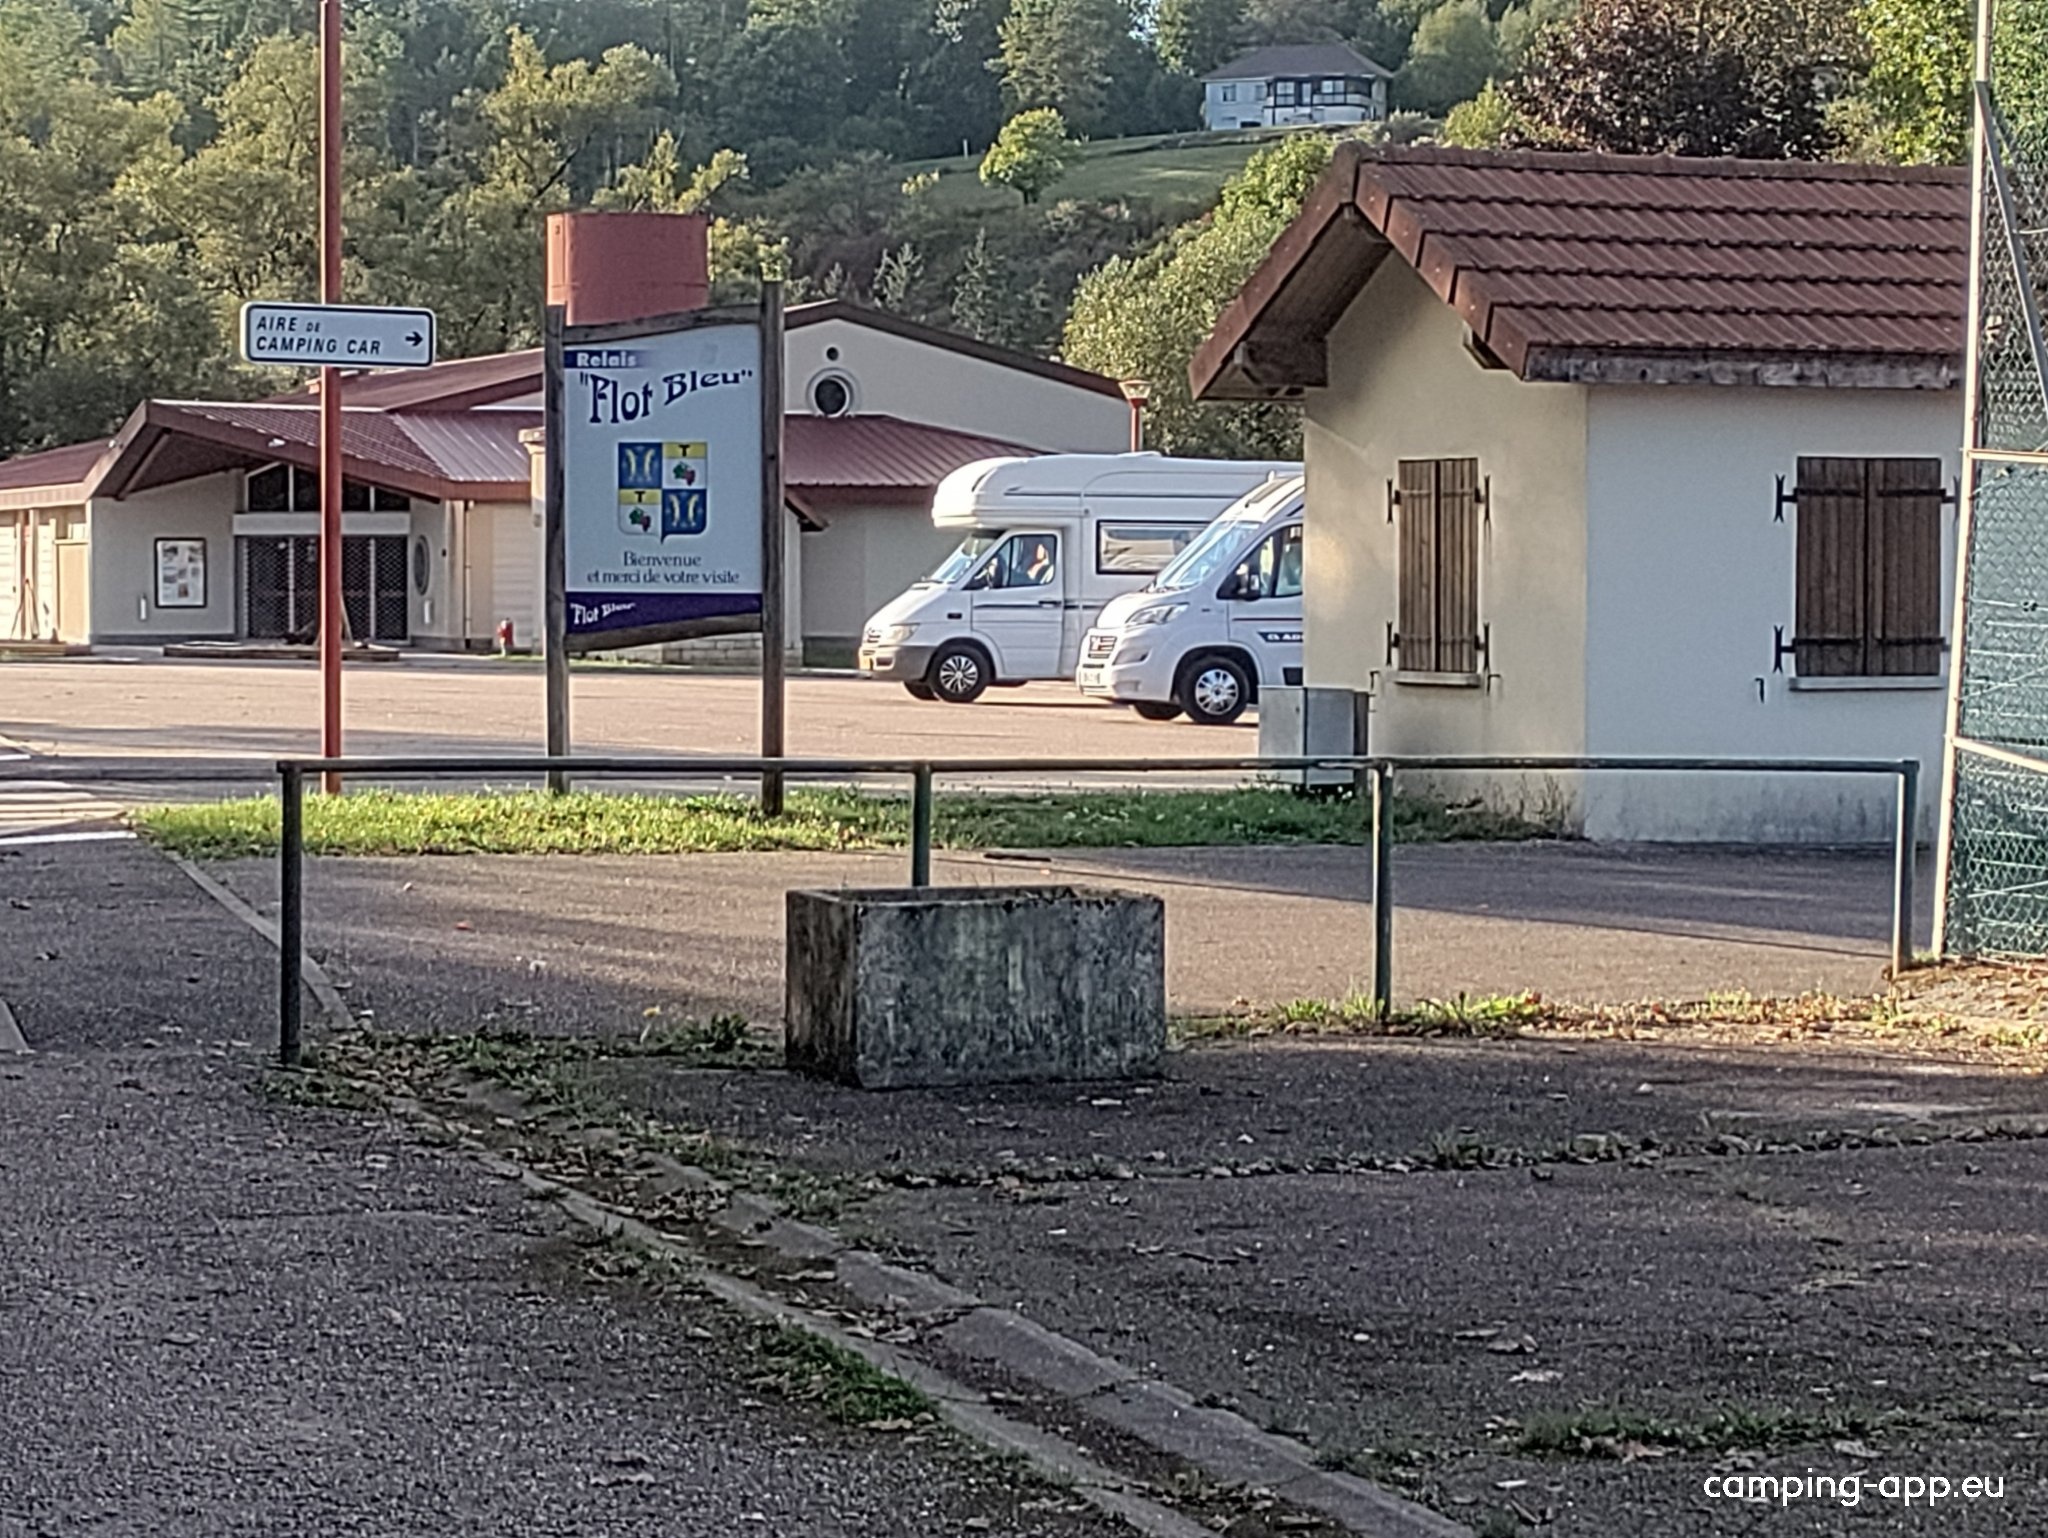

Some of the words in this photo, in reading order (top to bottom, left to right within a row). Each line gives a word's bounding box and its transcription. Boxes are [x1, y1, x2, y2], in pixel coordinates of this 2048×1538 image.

[256, 316, 298, 333] AIRE
[306, 322, 321, 333] DE
[256, 336, 338, 354] CAMPING
[347, 339, 381, 355] CAR
[576, 351, 638, 367] Relais
[623, 551, 702, 567] Bienvenue
[587, 570, 600, 584] et
[602, 570, 641, 584] merci
[643, 569, 661, 584] de
[664, 571, 700, 584] votre
[702, 570, 740, 584] visite
